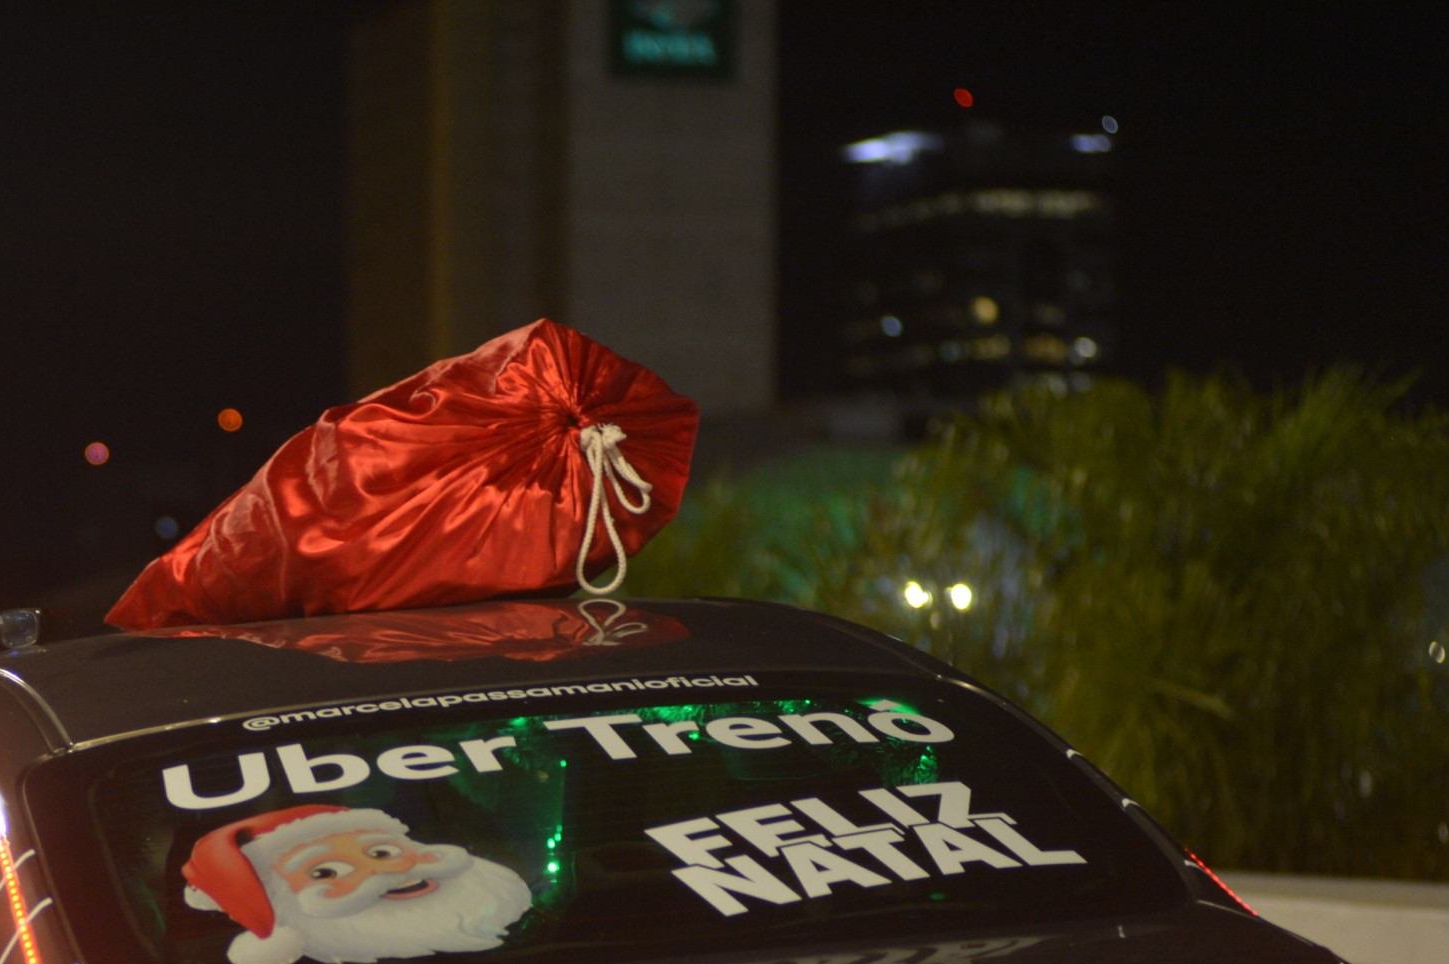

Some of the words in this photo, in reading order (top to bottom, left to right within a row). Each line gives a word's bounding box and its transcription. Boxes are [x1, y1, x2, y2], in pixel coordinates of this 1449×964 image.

[242, 675, 759, 731] @marcelapassamanioficial
[162, 735, 517, 811] Uber
[643, 780, 1019, 868] FELIZ
[671, 817, 1088, 917] NATAL
